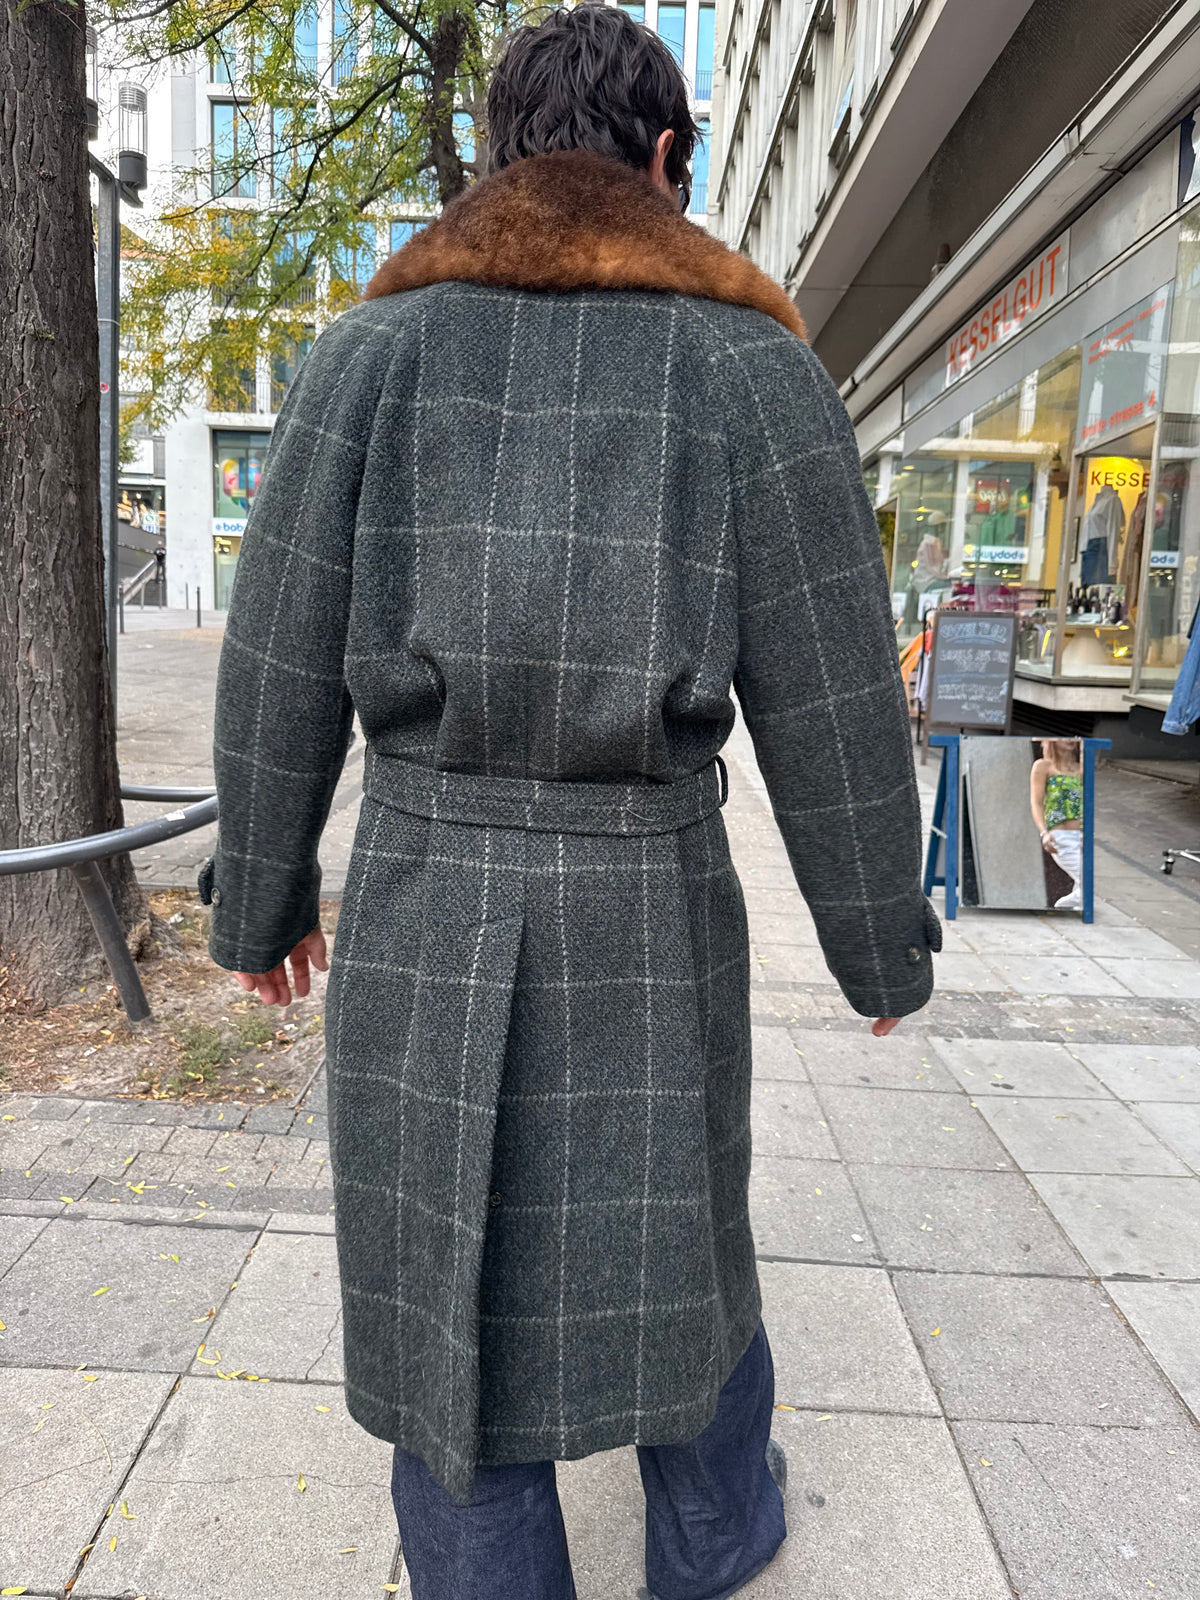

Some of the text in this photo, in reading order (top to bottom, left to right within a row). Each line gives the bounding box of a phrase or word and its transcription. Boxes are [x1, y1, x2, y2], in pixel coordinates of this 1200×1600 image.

[947, 244, 1062, 376] KESSELGUT
[1109, 400, 1144, 428] strasse
[1148, 391, 1155, 407] 4
[1091, 471, 1151, 487] KESSE
